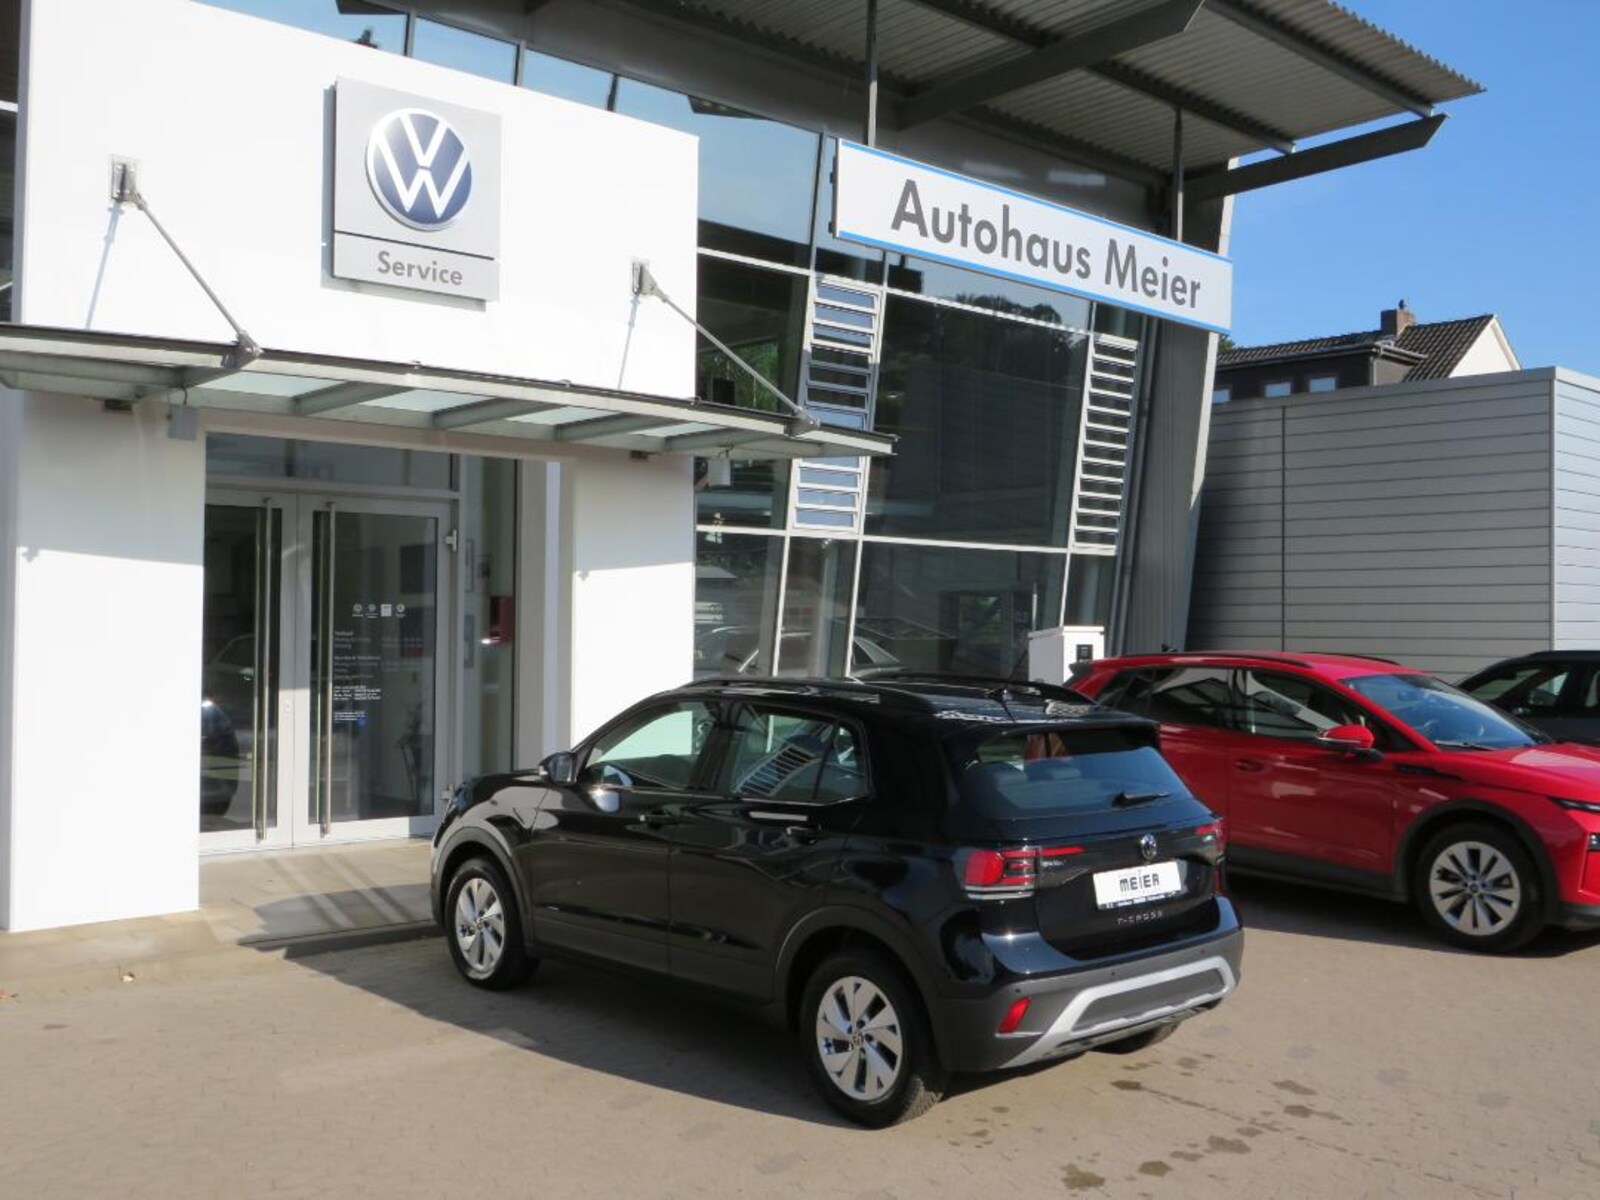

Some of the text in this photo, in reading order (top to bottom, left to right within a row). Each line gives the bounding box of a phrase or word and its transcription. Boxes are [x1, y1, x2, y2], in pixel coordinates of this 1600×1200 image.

[369, 109, 472, 228] VW
[377, 251, 464, 286] Service
[891, 179, 1201, 308] Autohaus Meier
[1119, 873, 1160, 892] MEIER
